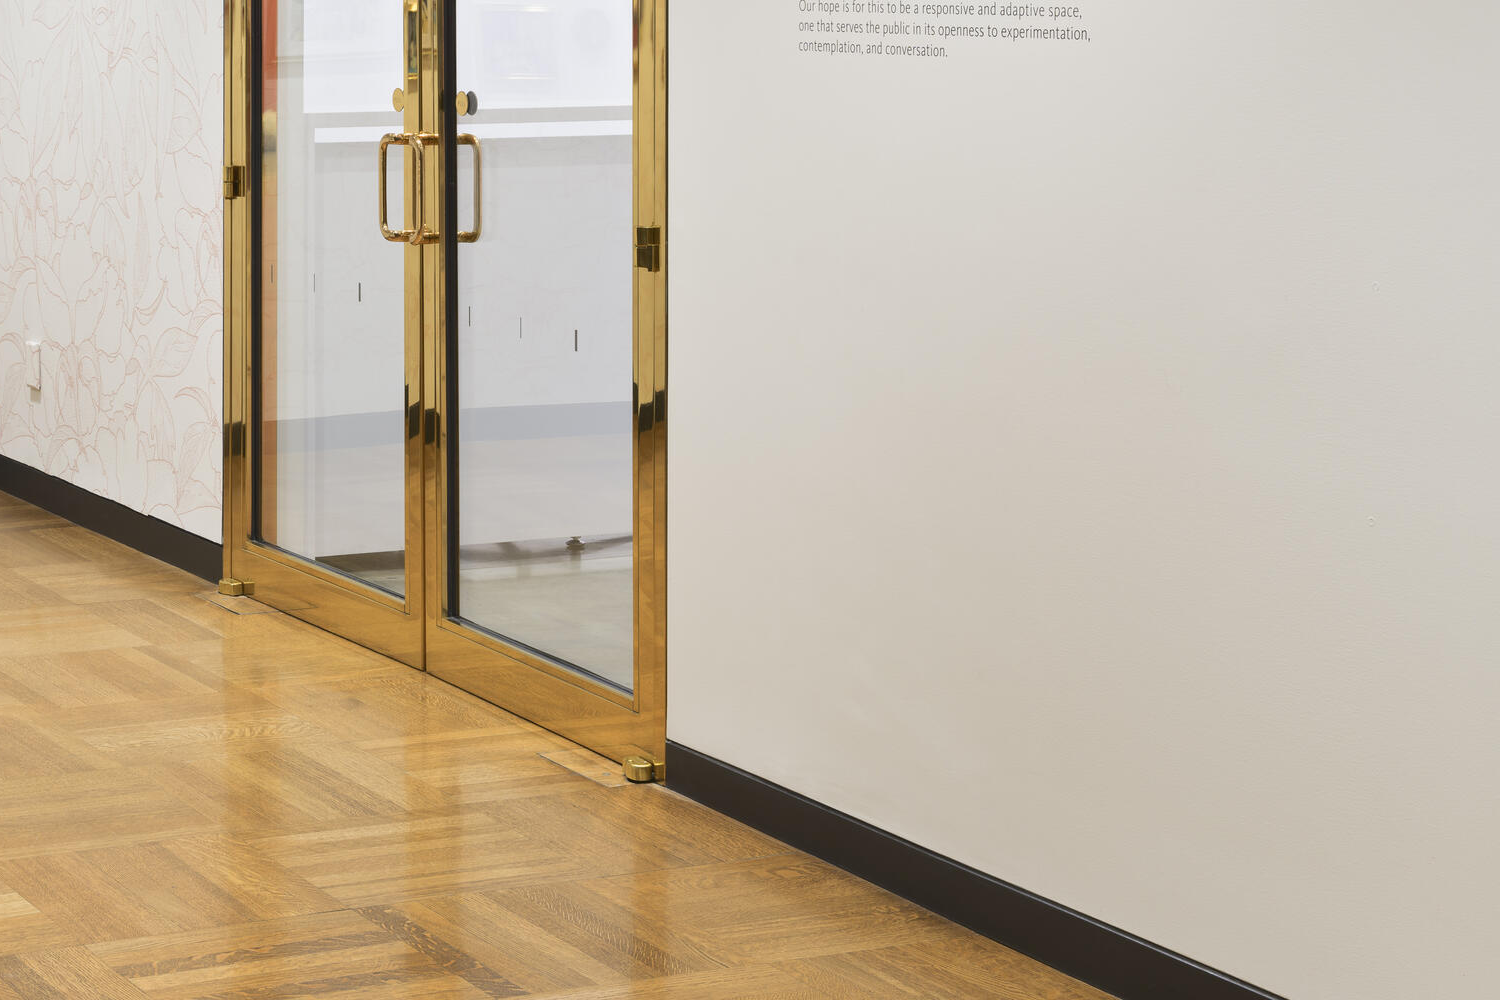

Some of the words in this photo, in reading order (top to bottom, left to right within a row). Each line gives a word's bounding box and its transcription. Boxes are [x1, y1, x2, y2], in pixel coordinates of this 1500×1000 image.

[799, 0, 816, 12] Our
[818, 0, 839, 15] hope
[843, 0, 849, 12] is
[852, 0, 865, 13] for
[868, 0, 884, 13] this
[887, 2, 896, 13] to
[900, 0, 910, 14] be
[922, 2, 974, 18] responsive
[978, 2, 996, 15] and
[1000, 2, 1045, 20] adaptive
[1049, 6, 1082, 20] space,
[799, 22, 814, 31] one
[817, 19, 833, 32] that
[837, 23, 863, 33] serves
[866, 20, 880, 33] the
[883, 21, 910, 37] public
[913, 23, 922, 34] in
[925, 22, 935, 35] its
[938, 26, 984, 39] openness
[988, 25, 998, 39] to
[1001, 26, 1090, 42] experimentation,
[799, 40, 863, 55] contemplation,
[866, 42, 882, 54] and
[886, 44, 947, 58] conversation.
